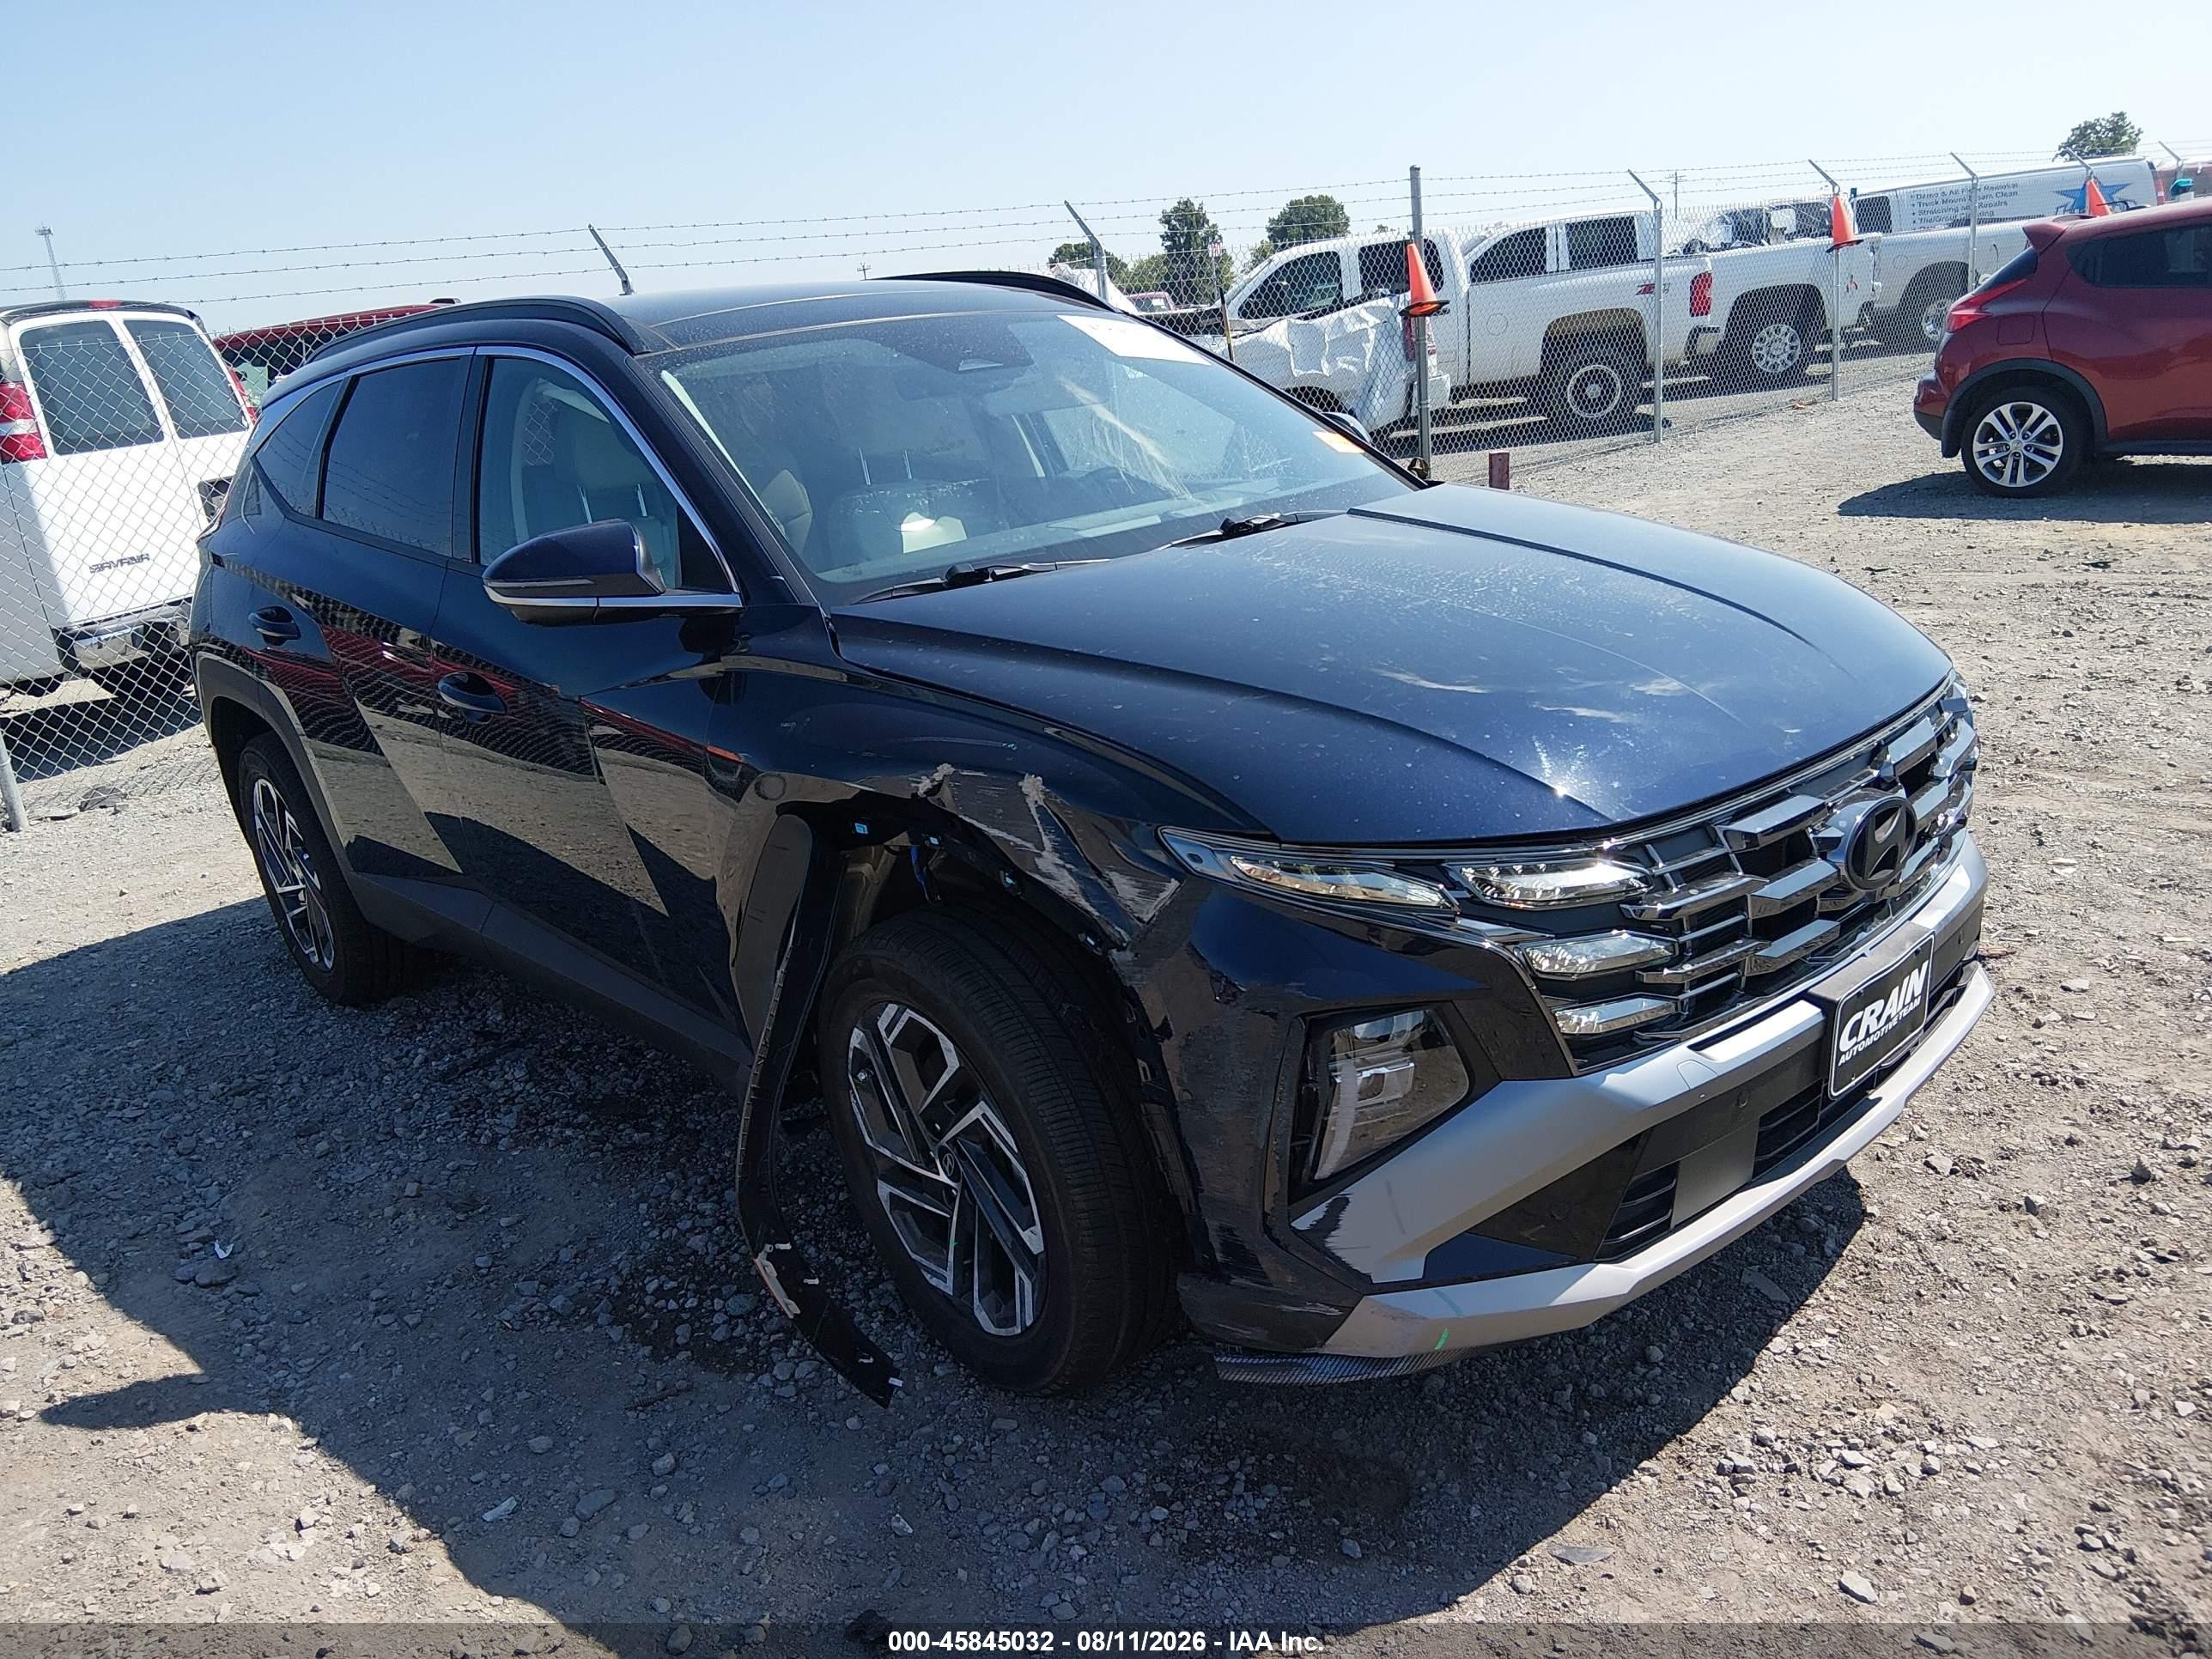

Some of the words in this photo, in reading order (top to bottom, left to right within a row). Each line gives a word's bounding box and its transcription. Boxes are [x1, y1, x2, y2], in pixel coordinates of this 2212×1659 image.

[1978, 201, 2008, 210] Repairs
[1838, 1016, 1899, 1066] AUTOMOTIVE
[1897, 994, 1922, 1020] TEAM
[1839, 959, 1929, 1052] CRAIN
